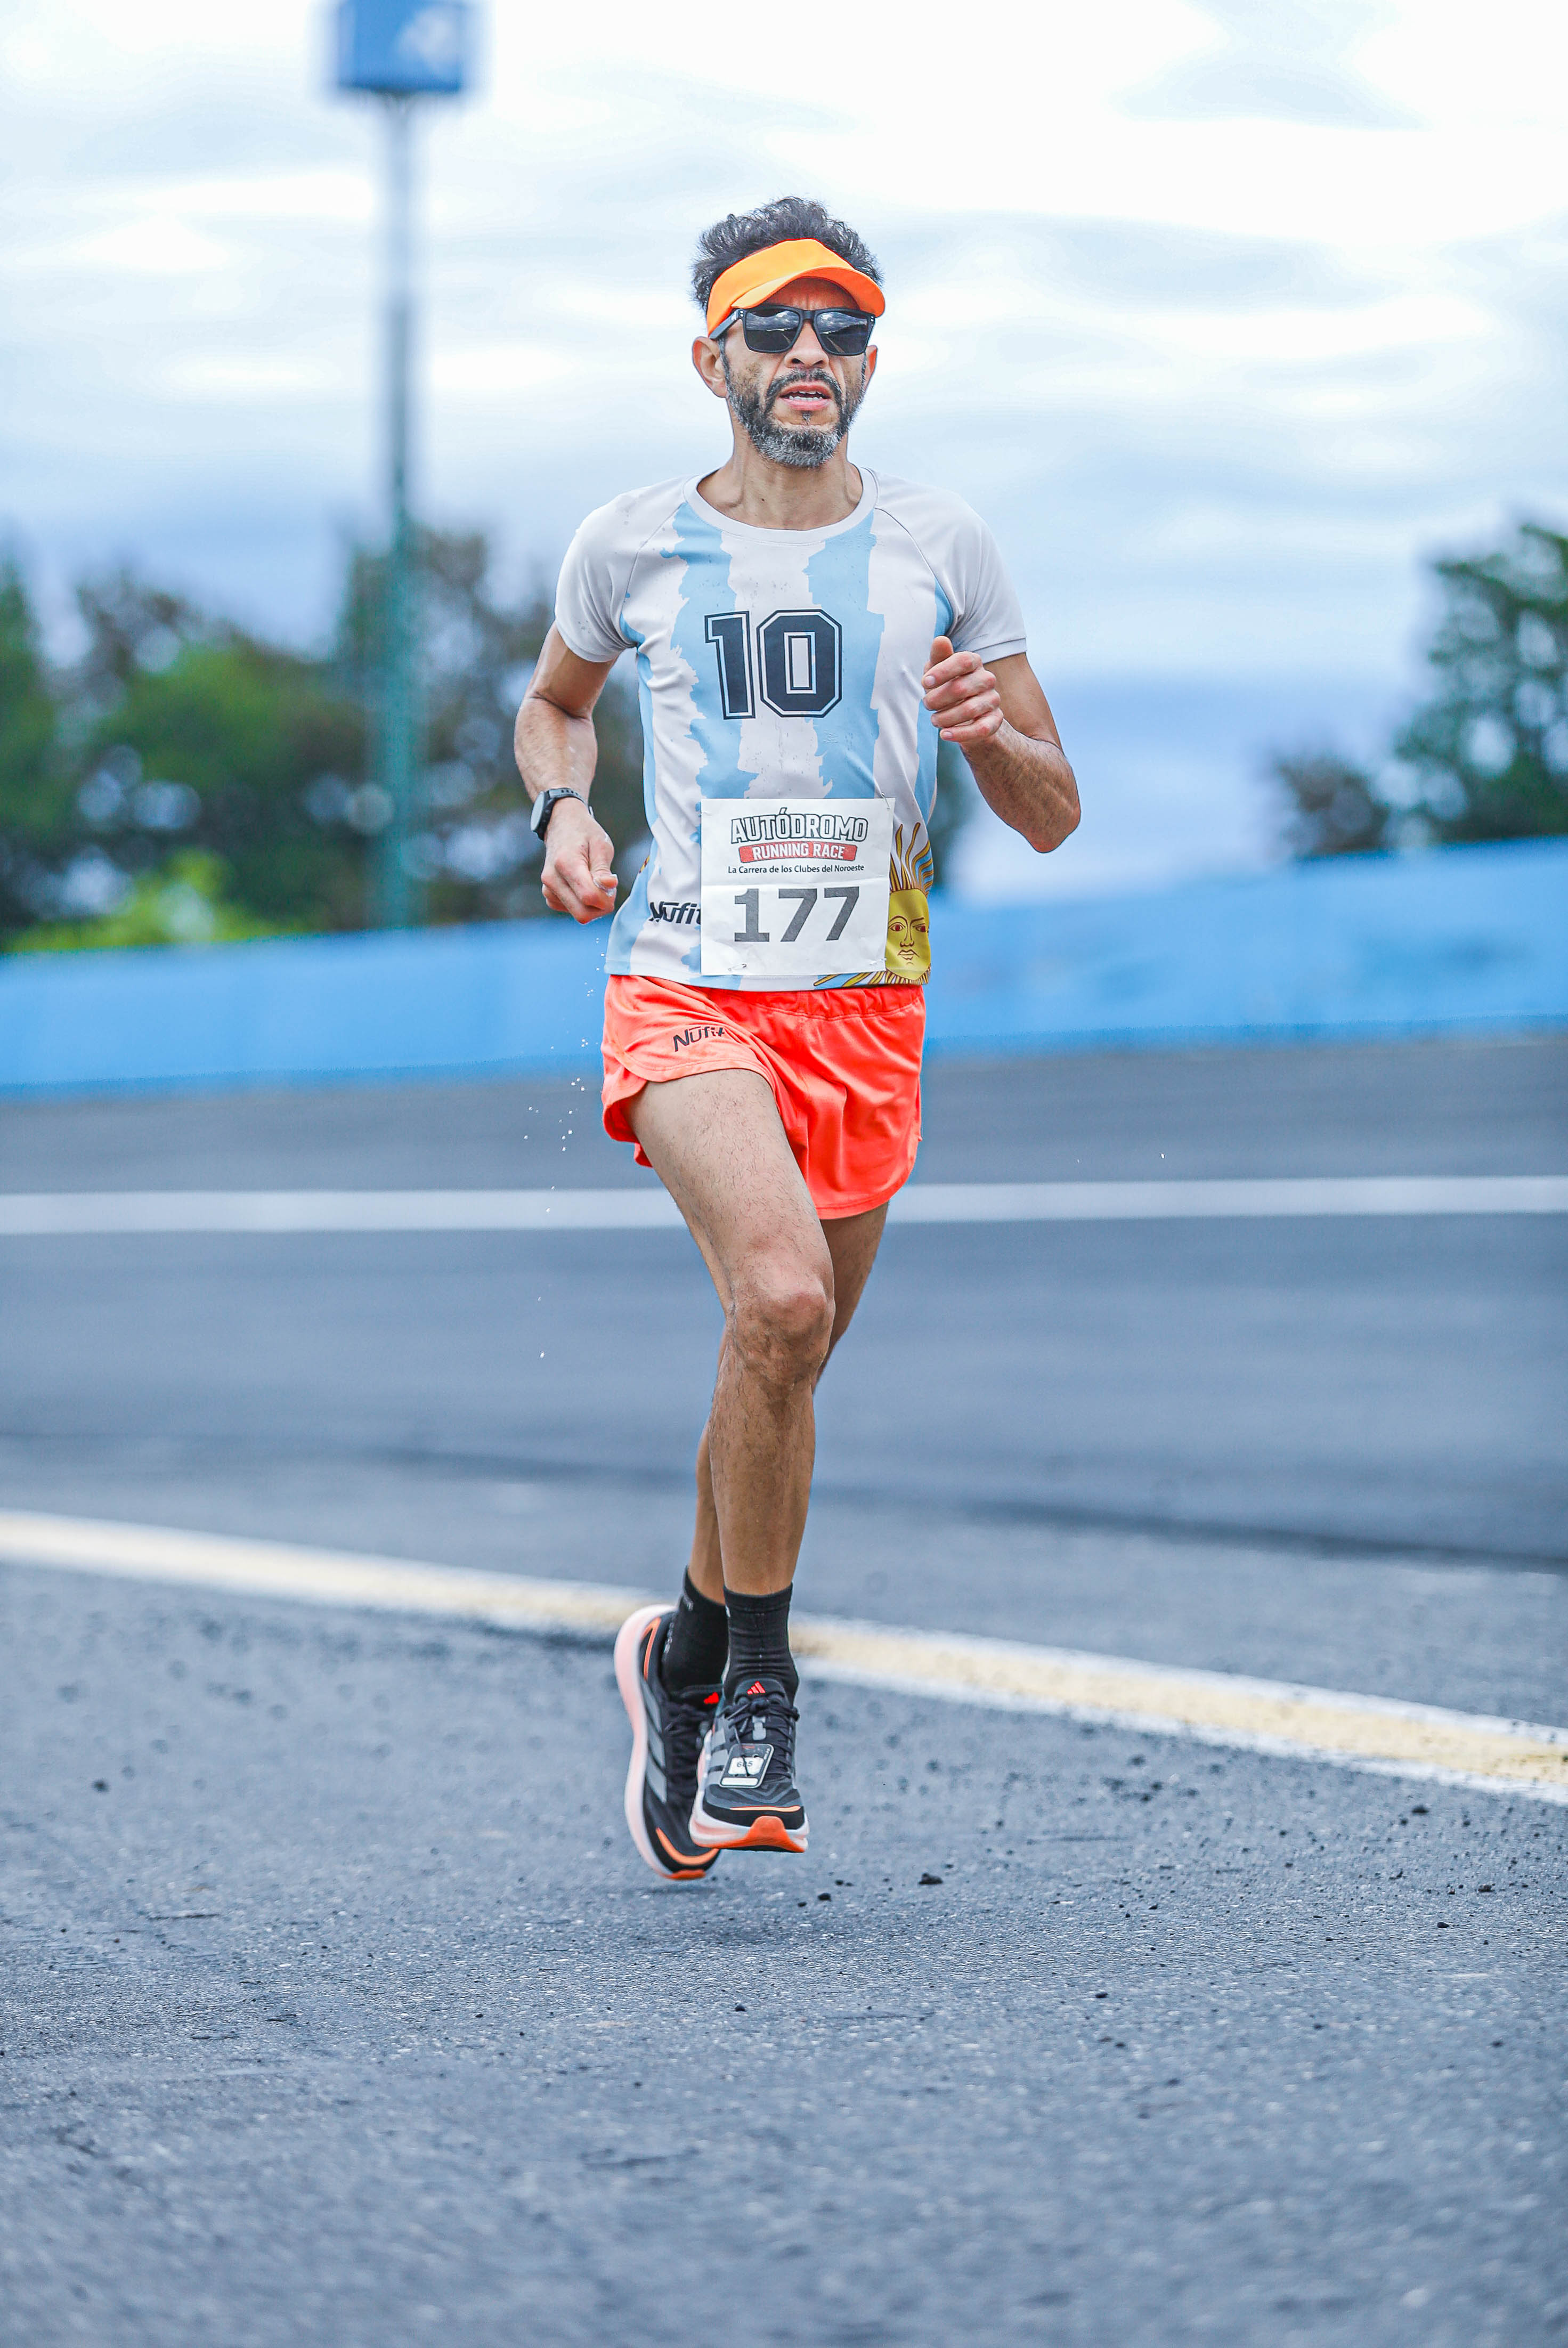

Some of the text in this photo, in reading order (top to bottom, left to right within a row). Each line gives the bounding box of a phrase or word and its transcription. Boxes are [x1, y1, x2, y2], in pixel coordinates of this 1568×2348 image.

[704, 608, 842, 720] 10
[731, 807, 868, 844] AUTÓDROMO
[752, 842, 846, 861] RUNNING RACE
[781, 865, 793, 873] los
[734, 886, 859, 943] 177
